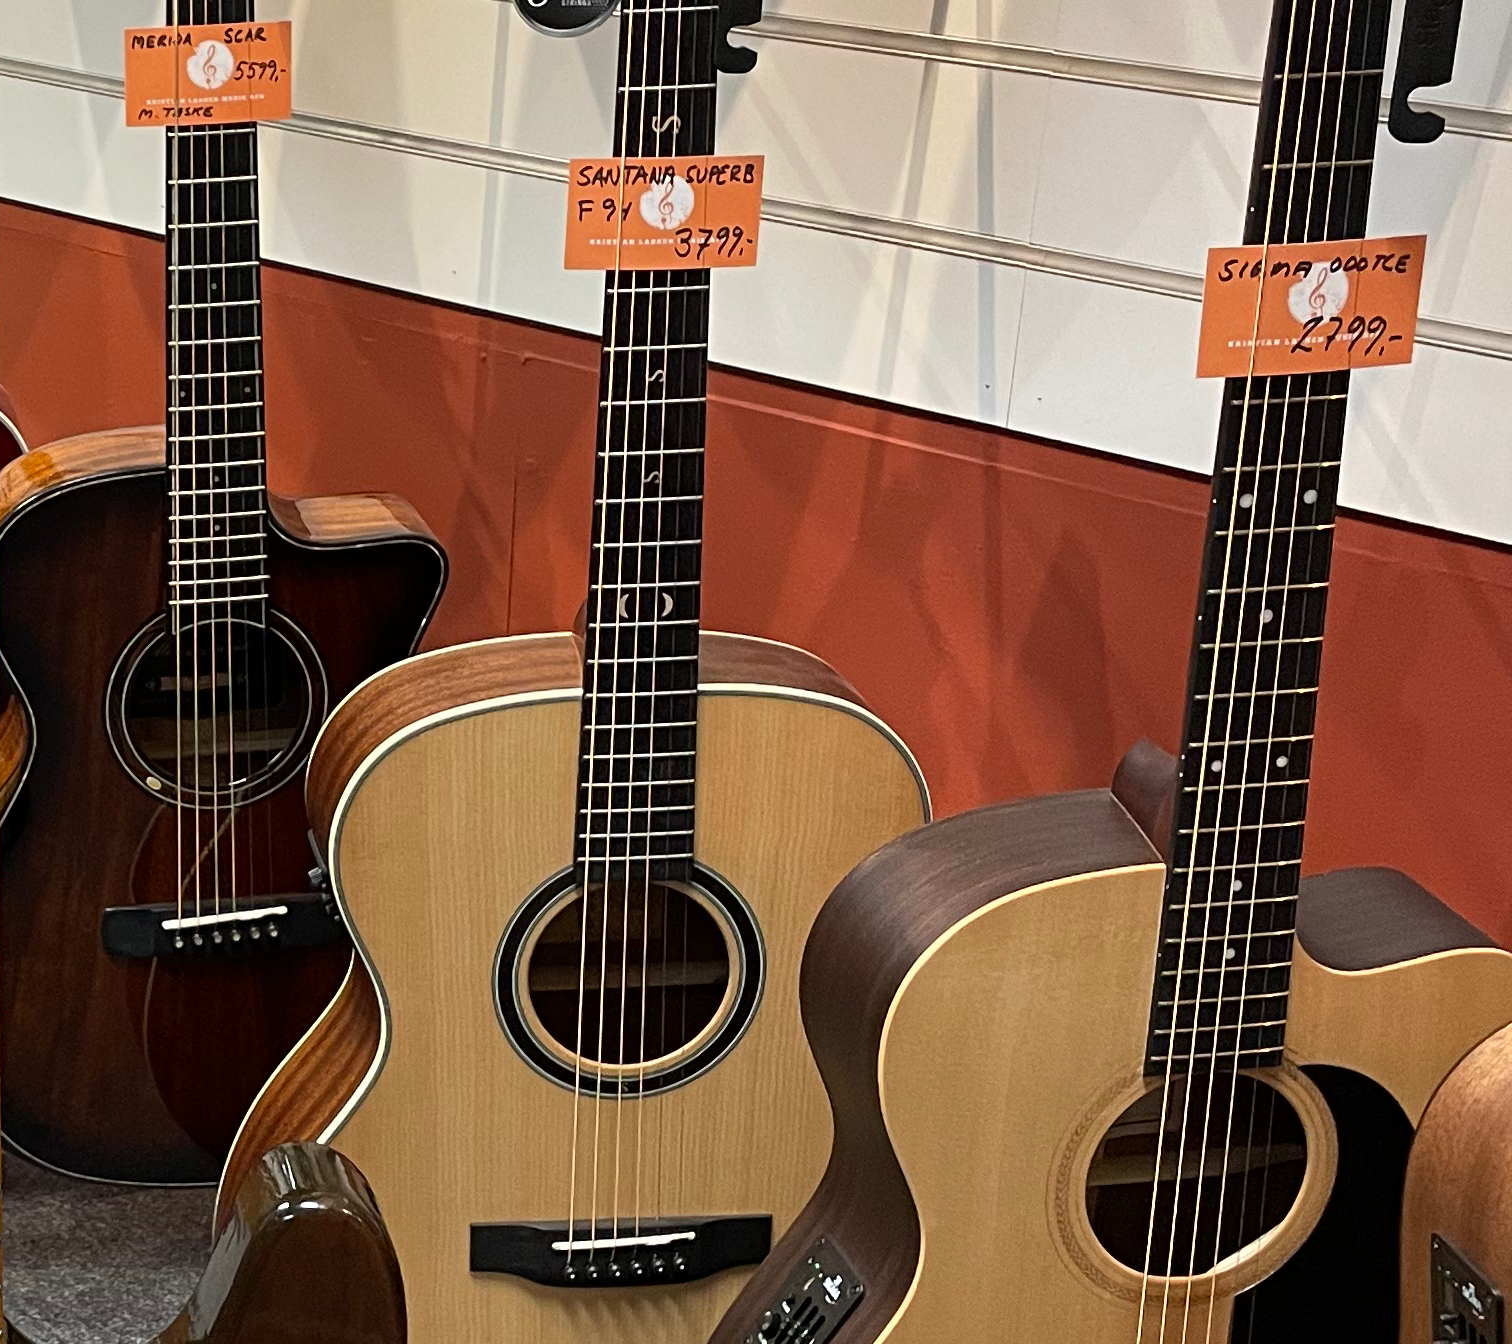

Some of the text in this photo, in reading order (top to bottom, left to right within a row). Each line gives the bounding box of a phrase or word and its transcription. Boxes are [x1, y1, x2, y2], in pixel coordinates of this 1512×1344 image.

[224, 27, 267, 44] SCAR
[577, 164, 755, 188] SANTANA SUPERB
[674, 226, 753, 260] 3799,-
[1218, 259, 1313, 282] SIGMA
[1291, 316, 1403, 357] 2799,-
